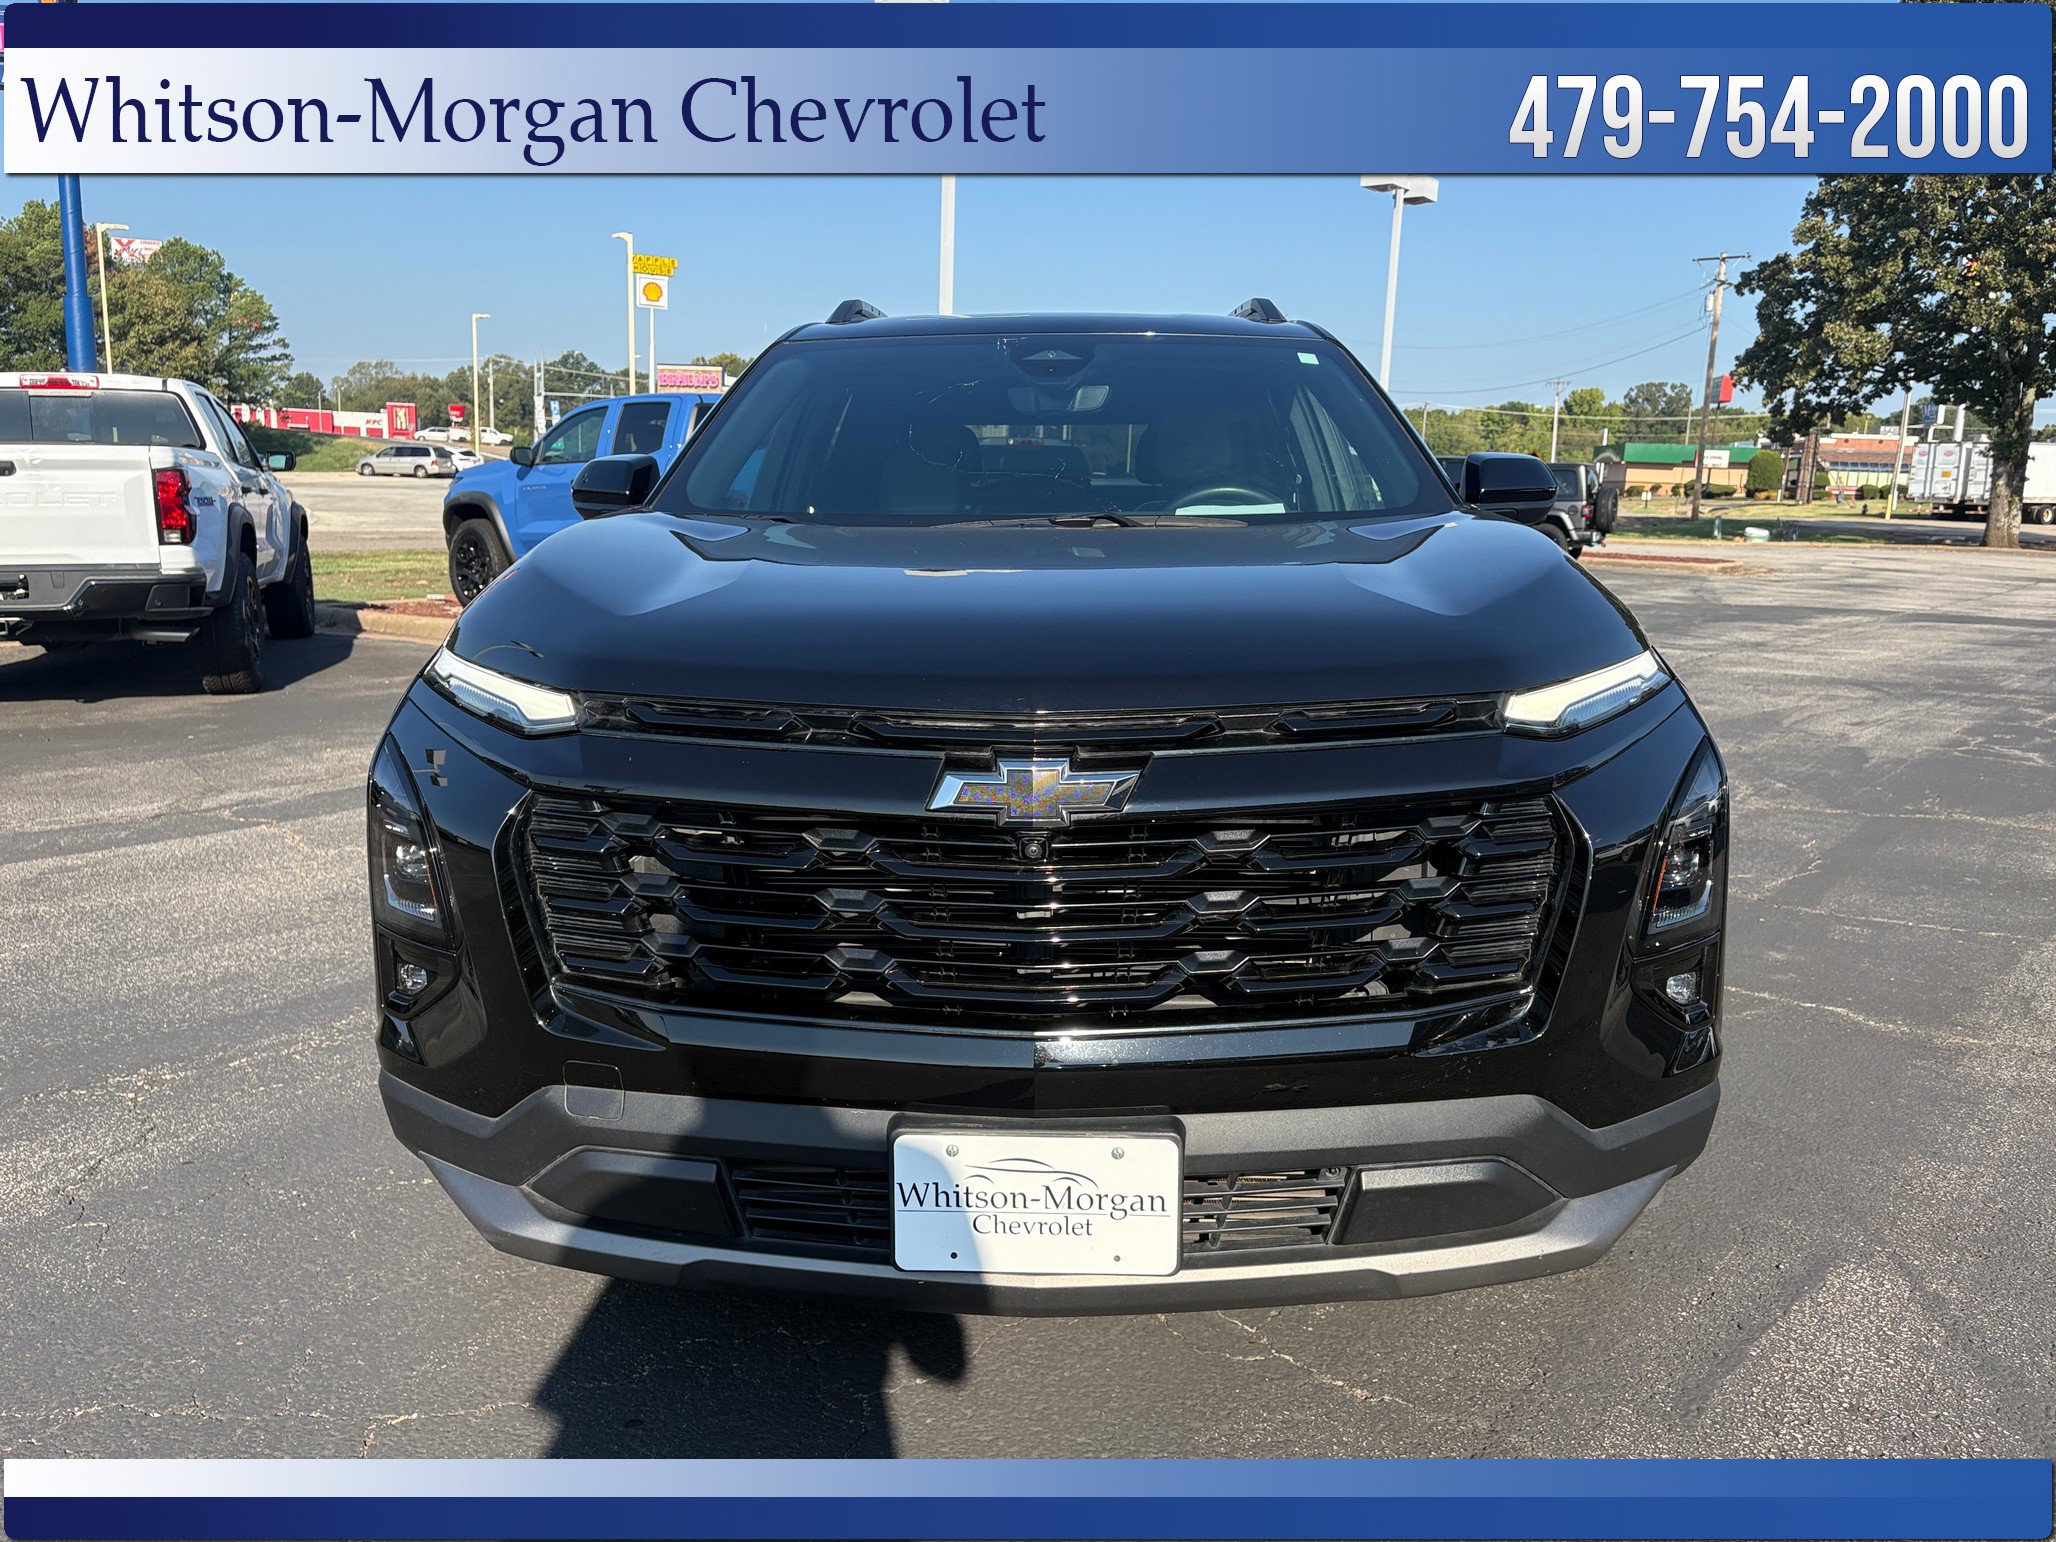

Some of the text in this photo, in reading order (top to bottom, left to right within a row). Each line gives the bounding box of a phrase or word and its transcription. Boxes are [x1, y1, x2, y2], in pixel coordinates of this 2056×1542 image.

[365, 418, 384, 426] KFC
[896, 1182, 1167, 1220] Whitson-Morgan
[973, 1213, 1093, 1236] Chevrolet
